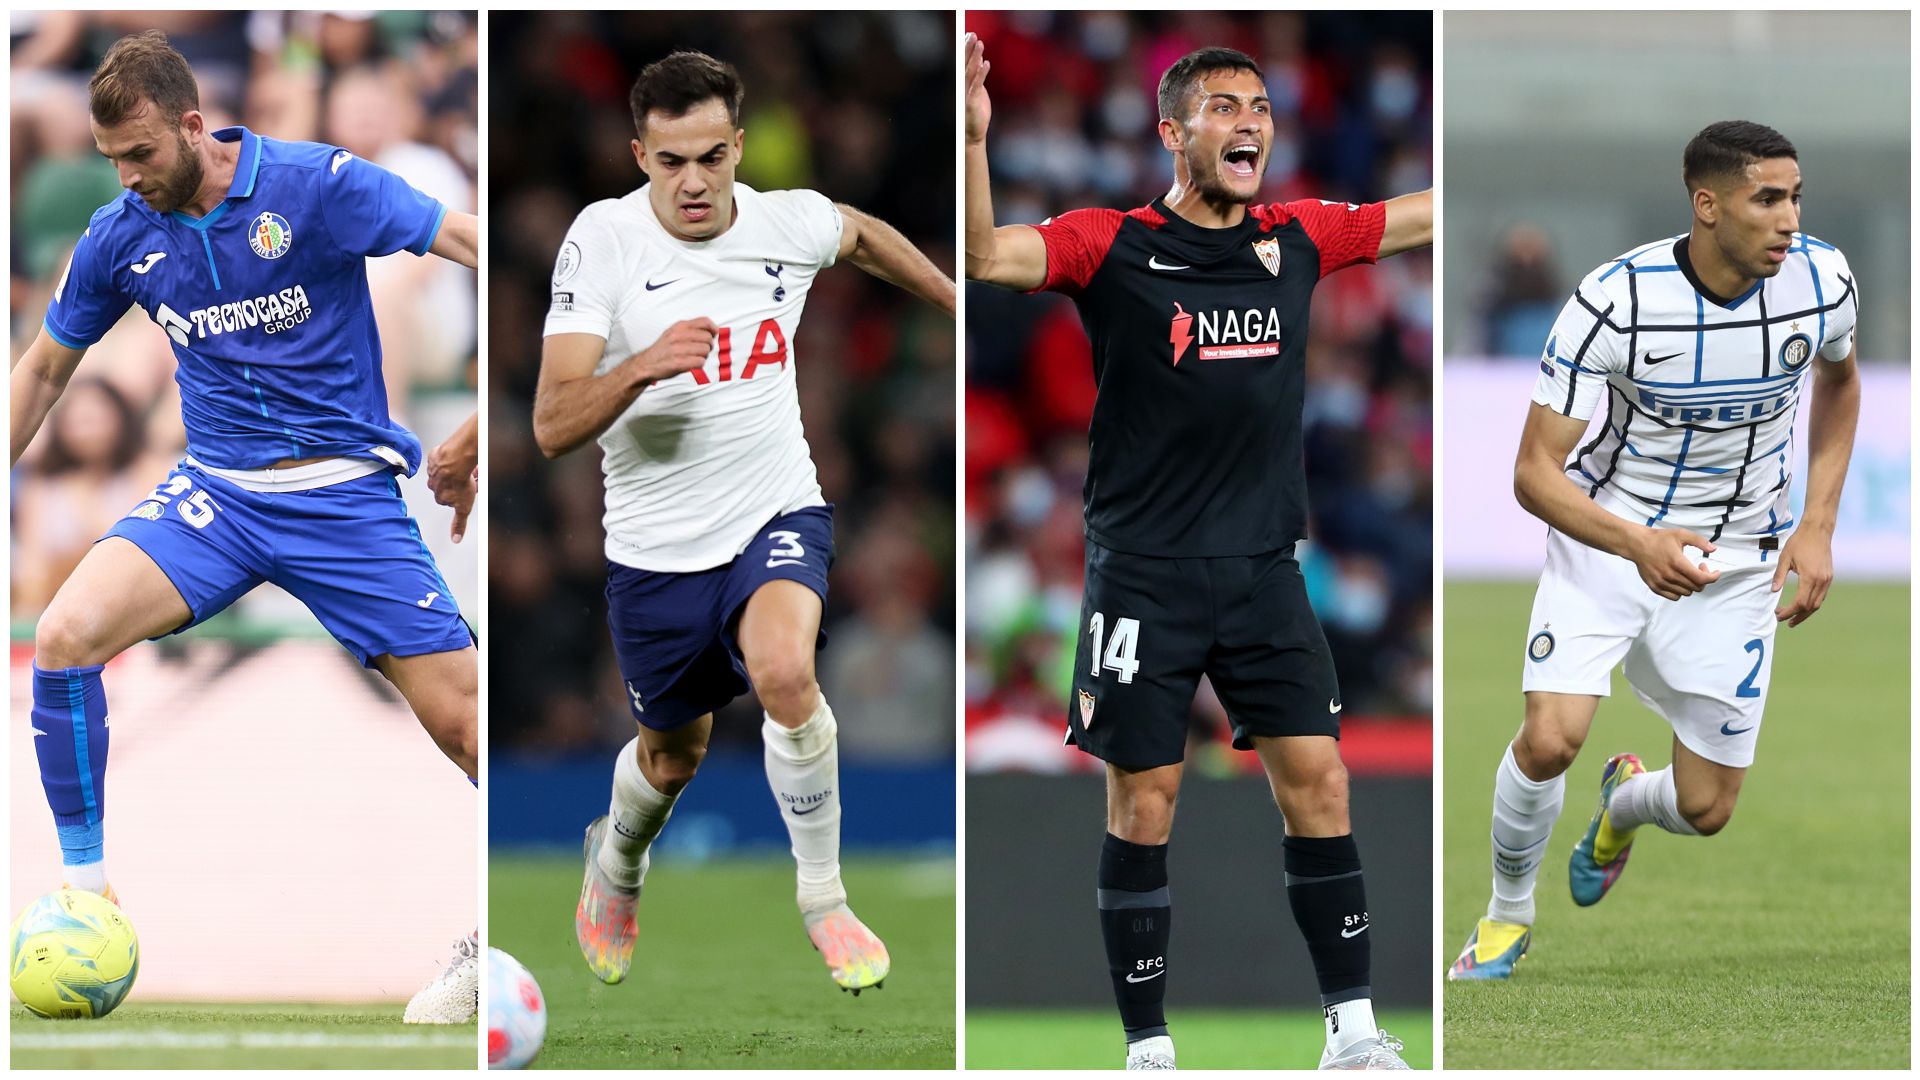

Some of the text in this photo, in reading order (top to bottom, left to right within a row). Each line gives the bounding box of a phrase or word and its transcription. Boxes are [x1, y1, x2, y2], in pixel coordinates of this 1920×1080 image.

[250, 237, 270, 257] GETAFE
[190, 285, 309, 338] TECNOCASA
[264, 307, 312, 334] GROUP
[1198, 307, 1281, 345] NAGA
[1203, 346, 1277, 357] Your Investing Super App
[768, 530, 805, 558] 3
[1089, 611, 1141, 685] 14
[1735, 638, 1765, 698] 2
[36, 947, 48, 955] FIFA
[1136, 956, 1164, 970] SFC
